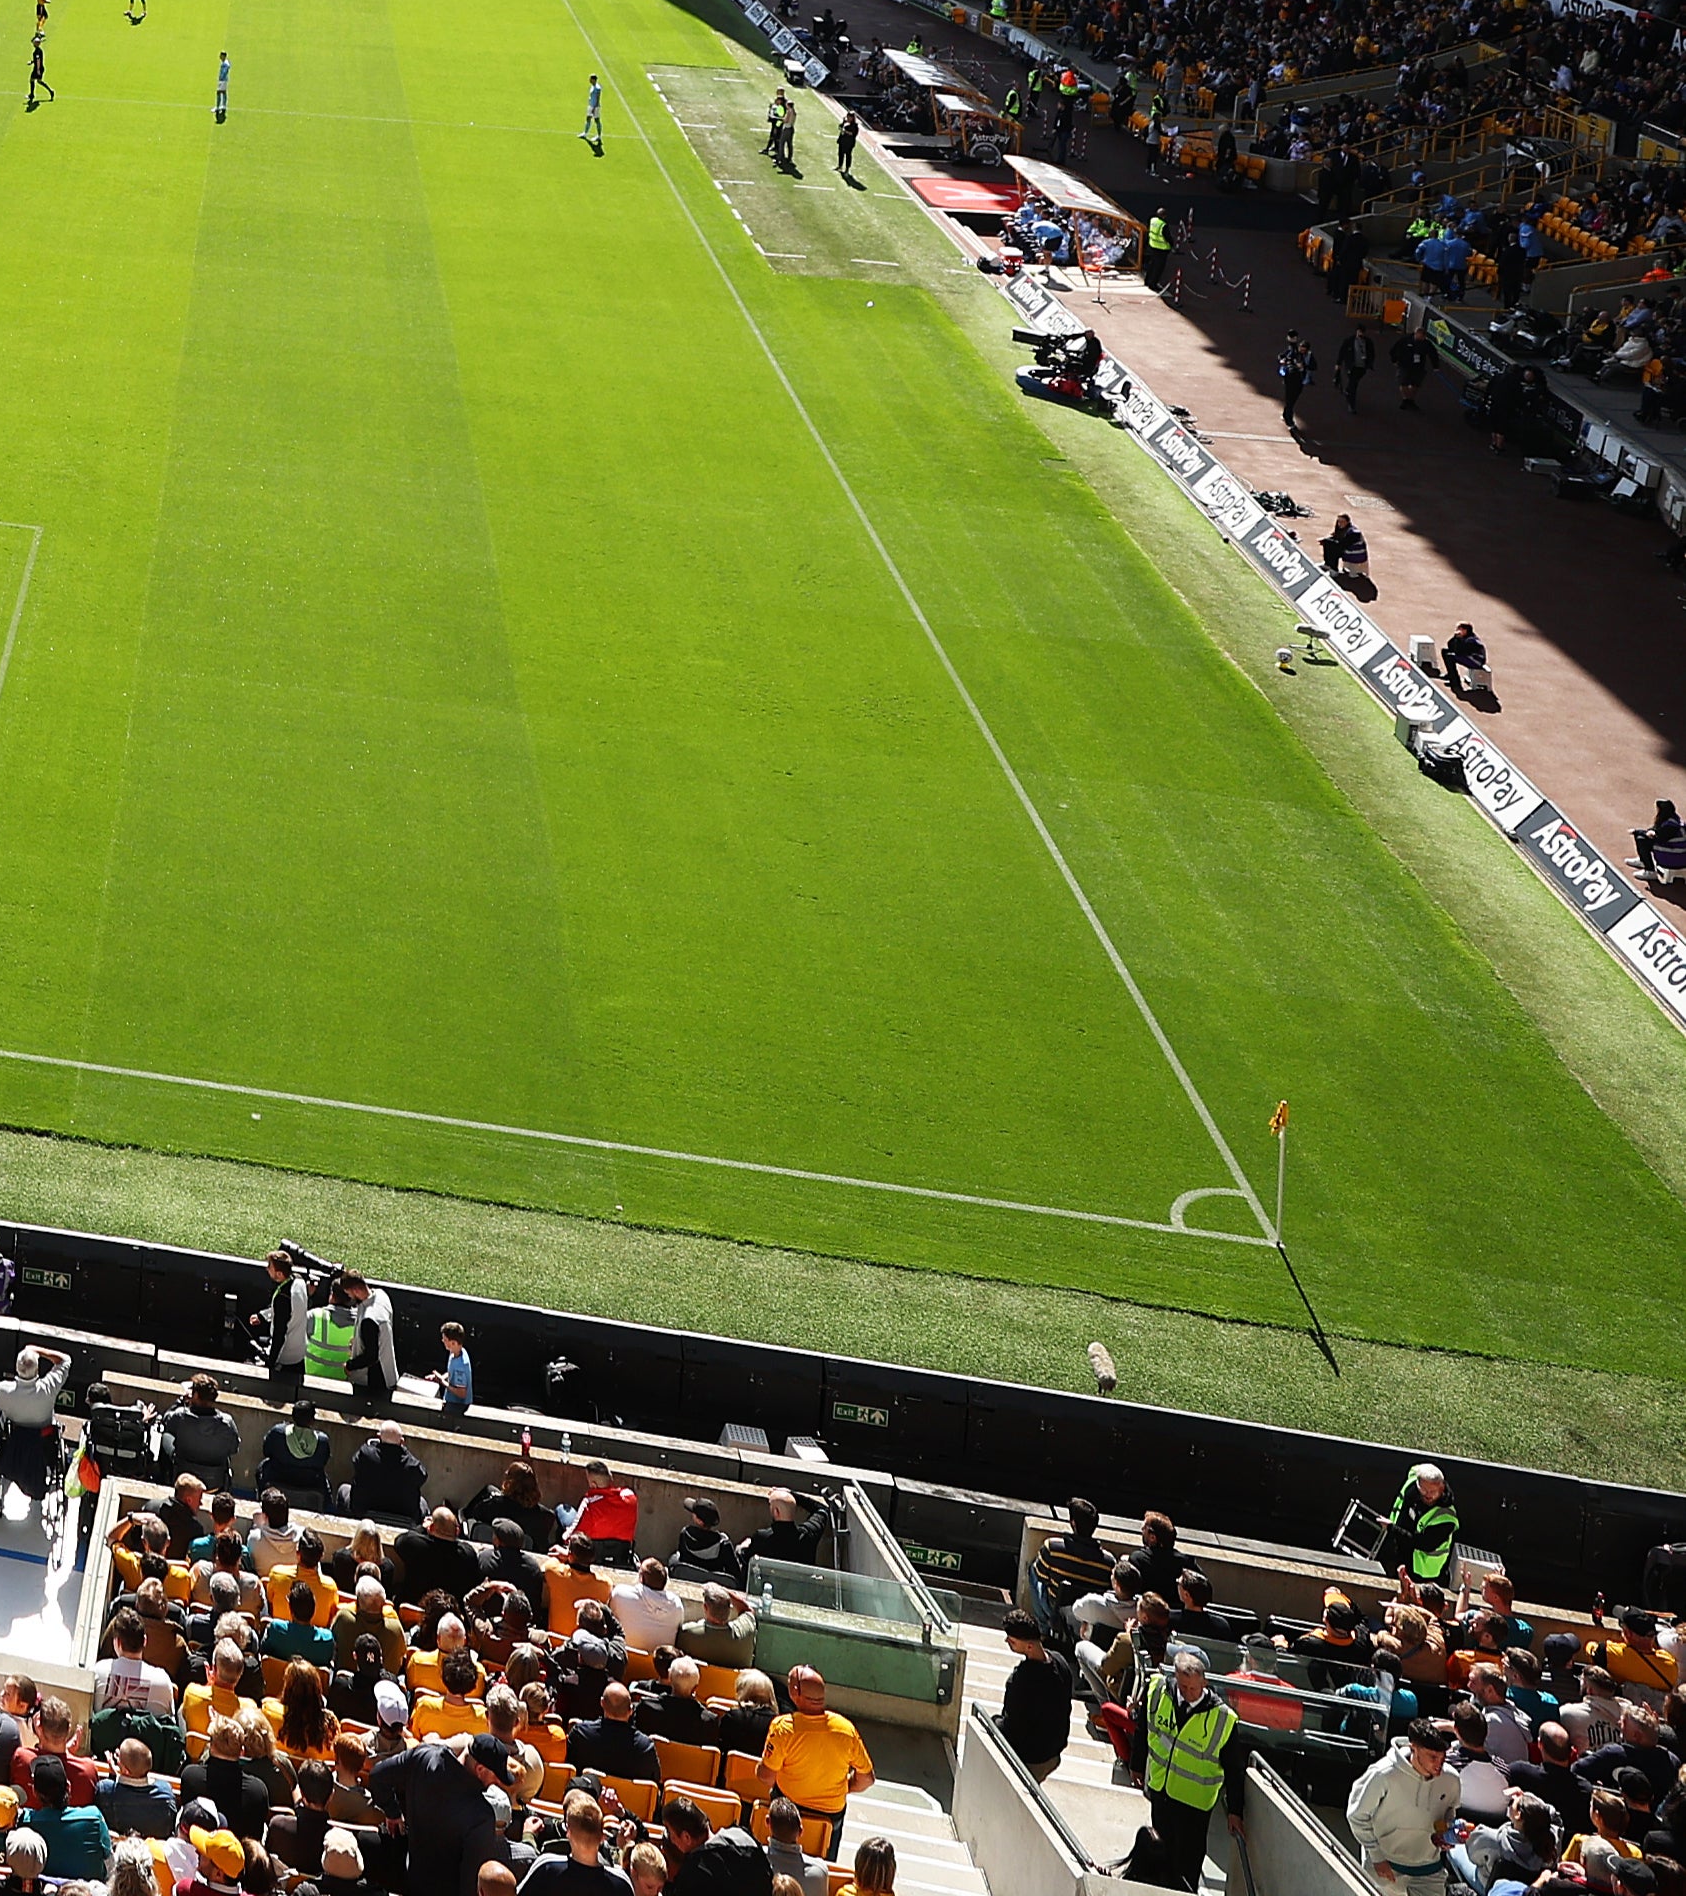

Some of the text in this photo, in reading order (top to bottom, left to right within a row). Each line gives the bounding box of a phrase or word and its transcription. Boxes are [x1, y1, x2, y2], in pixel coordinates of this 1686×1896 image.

[971, 132, 1011, 146] AstroPay
[1010, 271, 1046, 314] AstroPay
[1156, 429, 1206, 476] AstroPay
[1204, 476, 1252, 528] AstroPay
[1250, 527, 1309, 588] AstroPay
[1310, 588, 1371, 653] AstroPay
[1451, 731, 1524, 812] AstroPay
[1530, 817, 1621, 911] AstroPay
[1628, 920, 1686, 994] Astro
[25, 1271, 41, 1281] Exit
[836, 1407, 854, 1417] Exit
